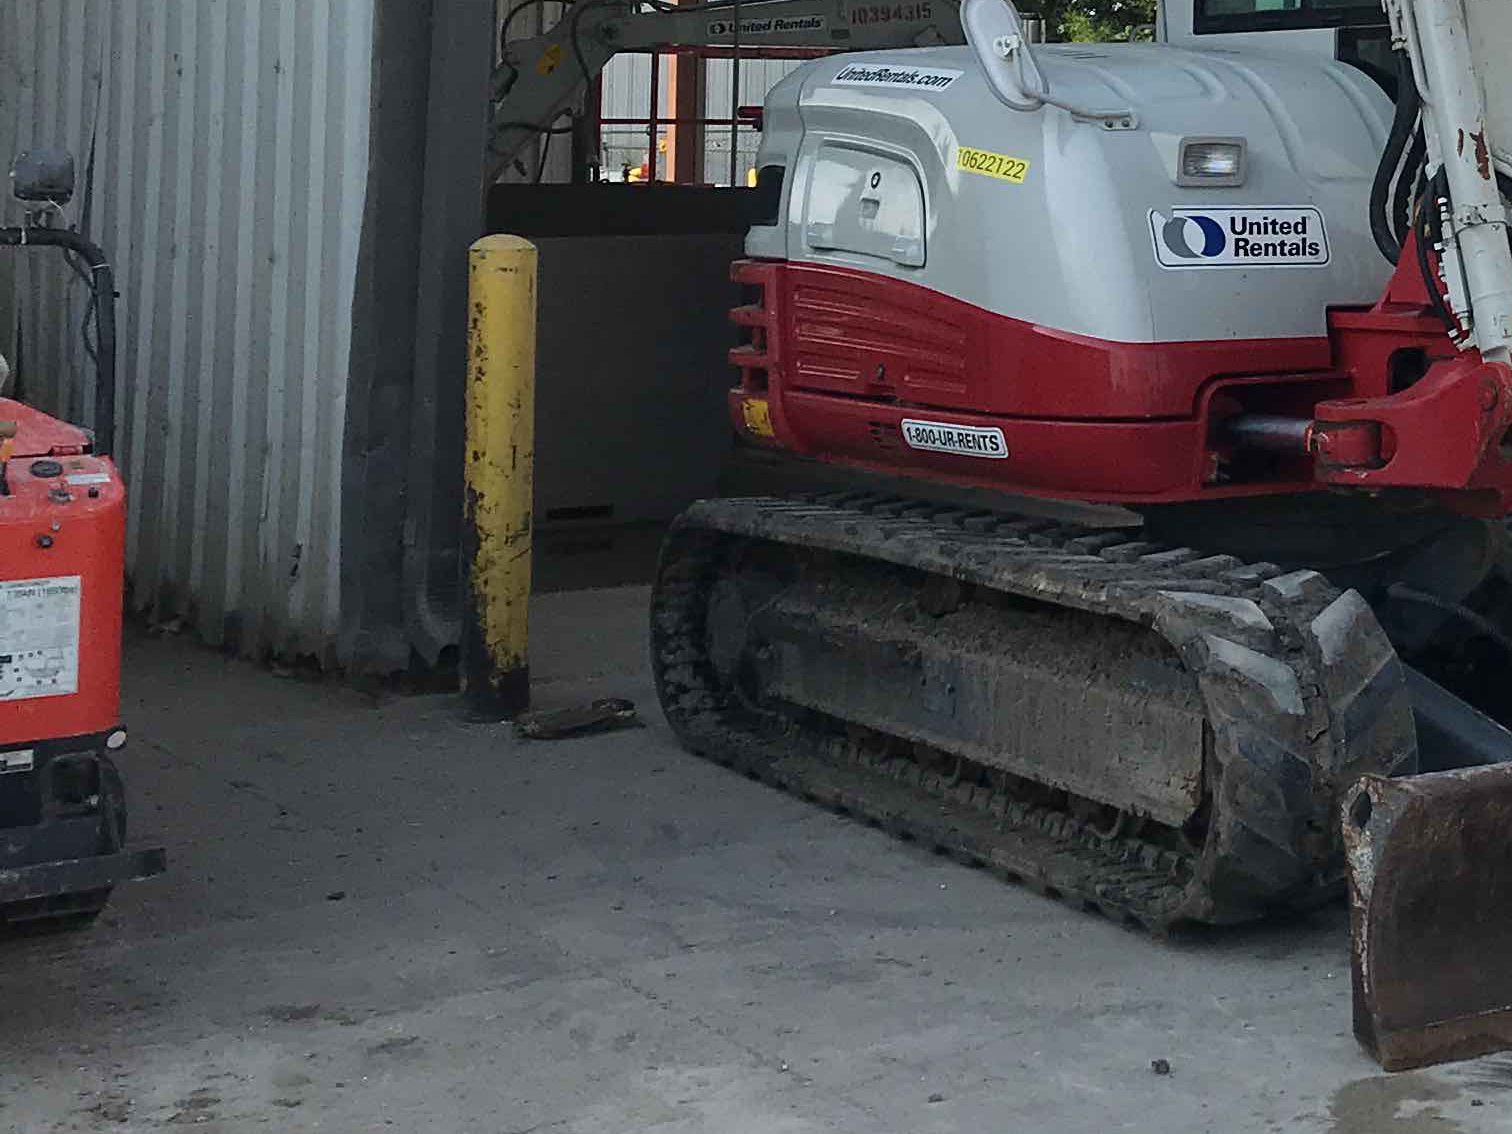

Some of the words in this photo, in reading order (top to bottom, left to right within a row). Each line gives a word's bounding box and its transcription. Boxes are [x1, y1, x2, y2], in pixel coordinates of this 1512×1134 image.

[774, 17, 822, 32] Rentals
[852, 4, 932, 25] 10394315
[836, 67, 953, 88] UnitedRentals.com
[958, 149, 1026, 180] 10622122
[1230, 216, 1307, 235] United
[1234, 237, 1320, 257] Rentals
[905, 426, 1000, 452] 1-800-UR-RENTS
